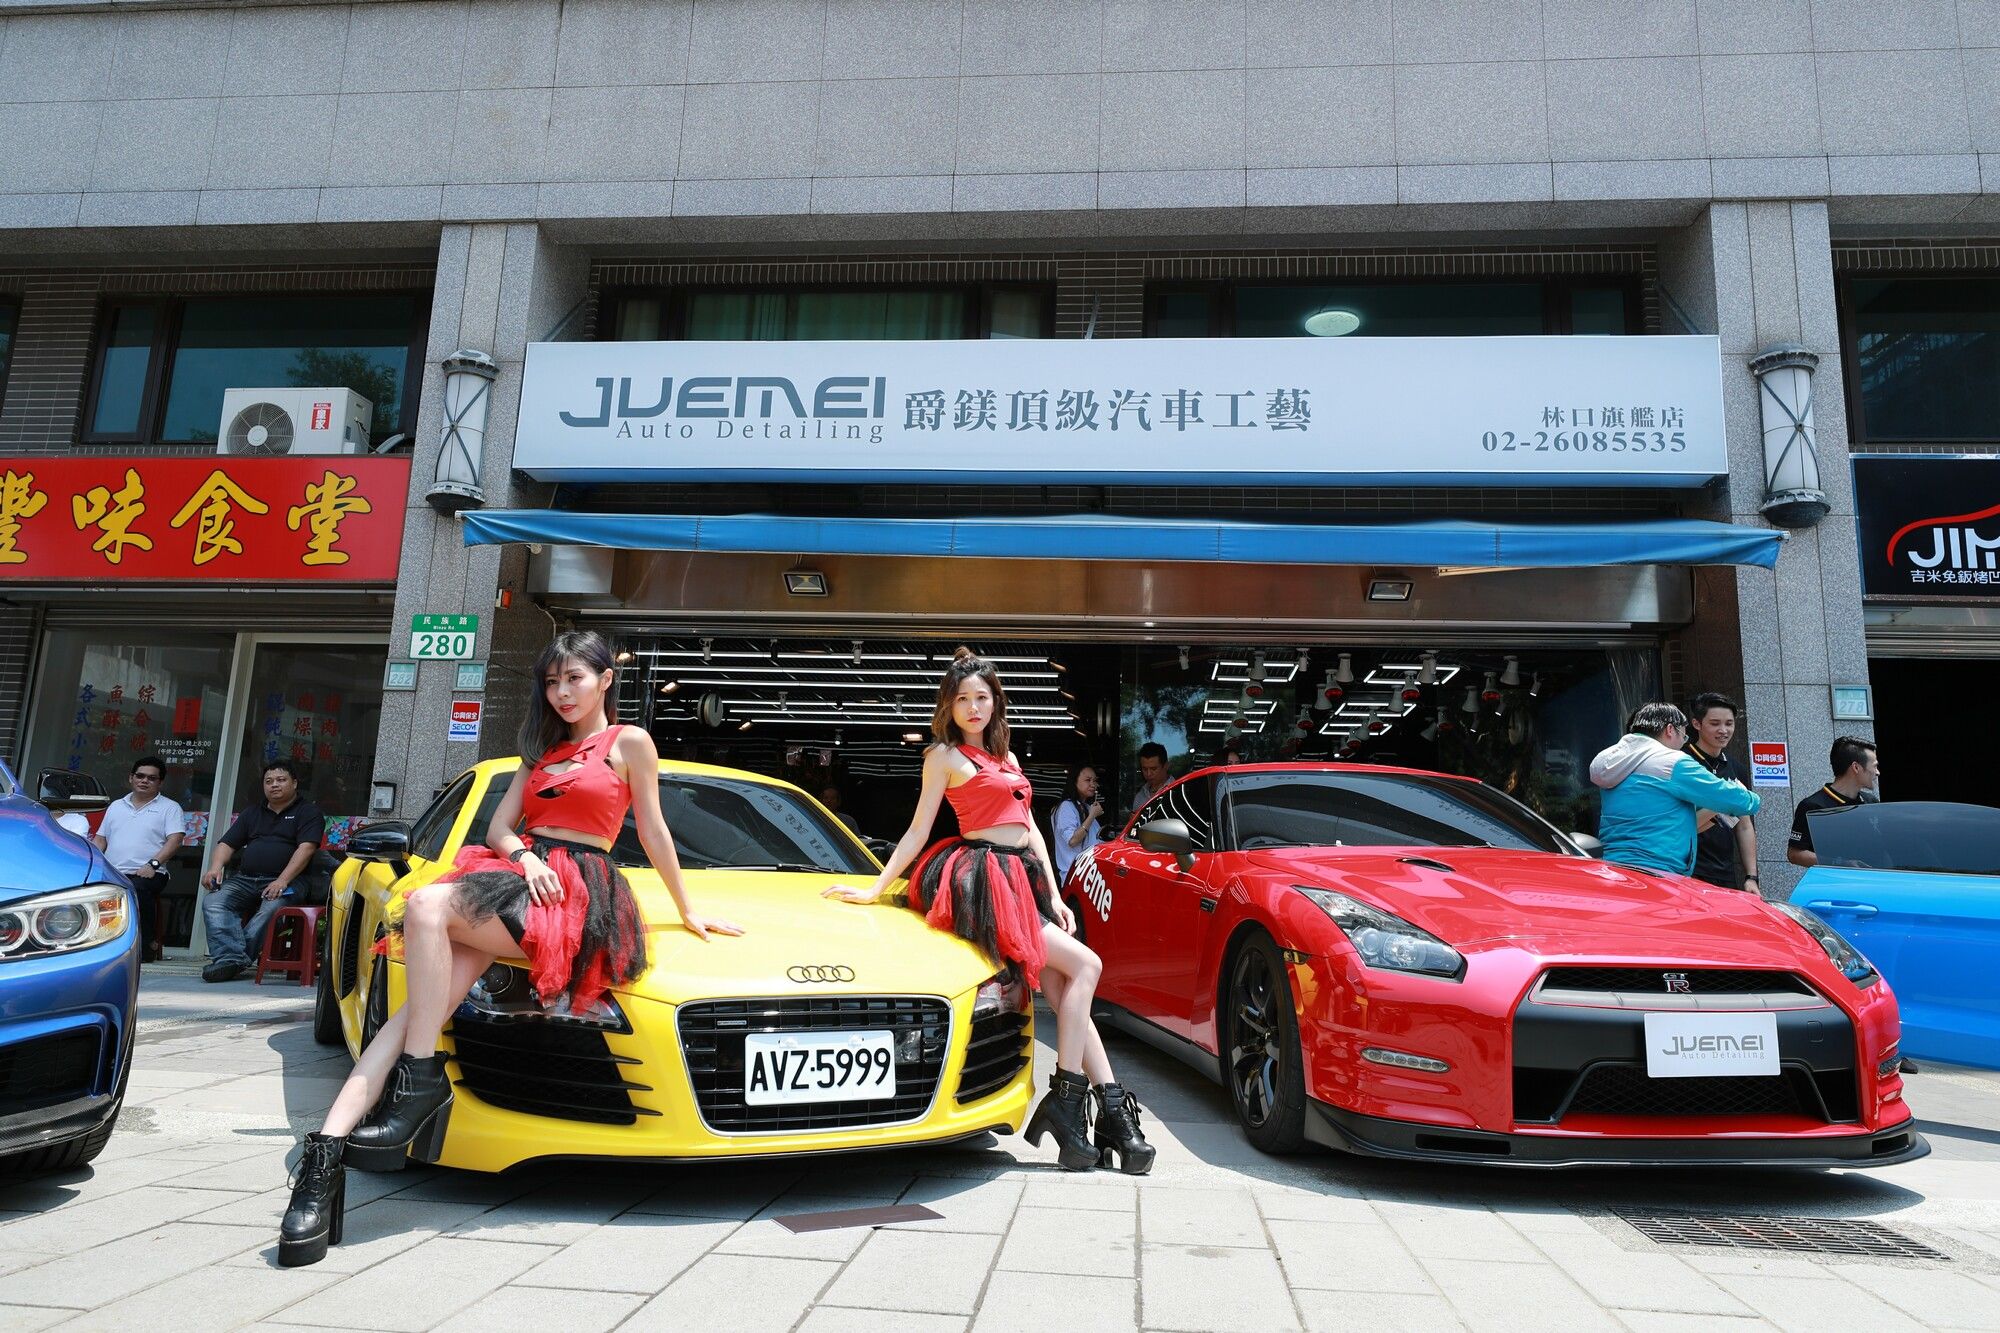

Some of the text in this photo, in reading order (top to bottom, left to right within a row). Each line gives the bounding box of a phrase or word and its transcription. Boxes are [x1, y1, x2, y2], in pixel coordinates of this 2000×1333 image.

[559, 377, 887, 427] JUEMEI
[903, 388, 1312, 432] 爵鎂頂級汽車工藝
[1541, 406, 1685, 428] 林口旗艦店
[616, 420, 885, 444] Auto Detailing
[1482, 431, 1687, 452] 02-26085535
[422, 616, 468, 625] 民族路
[418, 634, 467, 657] 280
[390, 673, 412, 685] 282
[459, 674, 481, 685] 280
[1839, 701, 1865, 713] 278
[453, 711, 478, 720] 中興保全
[1755, 753, 1784, 763] 中興保全
[1755, 766, 1786, 775] SECOM
[1664, 979, 1693, 993] R
[1662, 1035, 1764, 1055] JUEMEI
[1681, 1052, 1765, 1060] Auto Detailing
[750, 1047, 891, 1092] AVZ-5999
